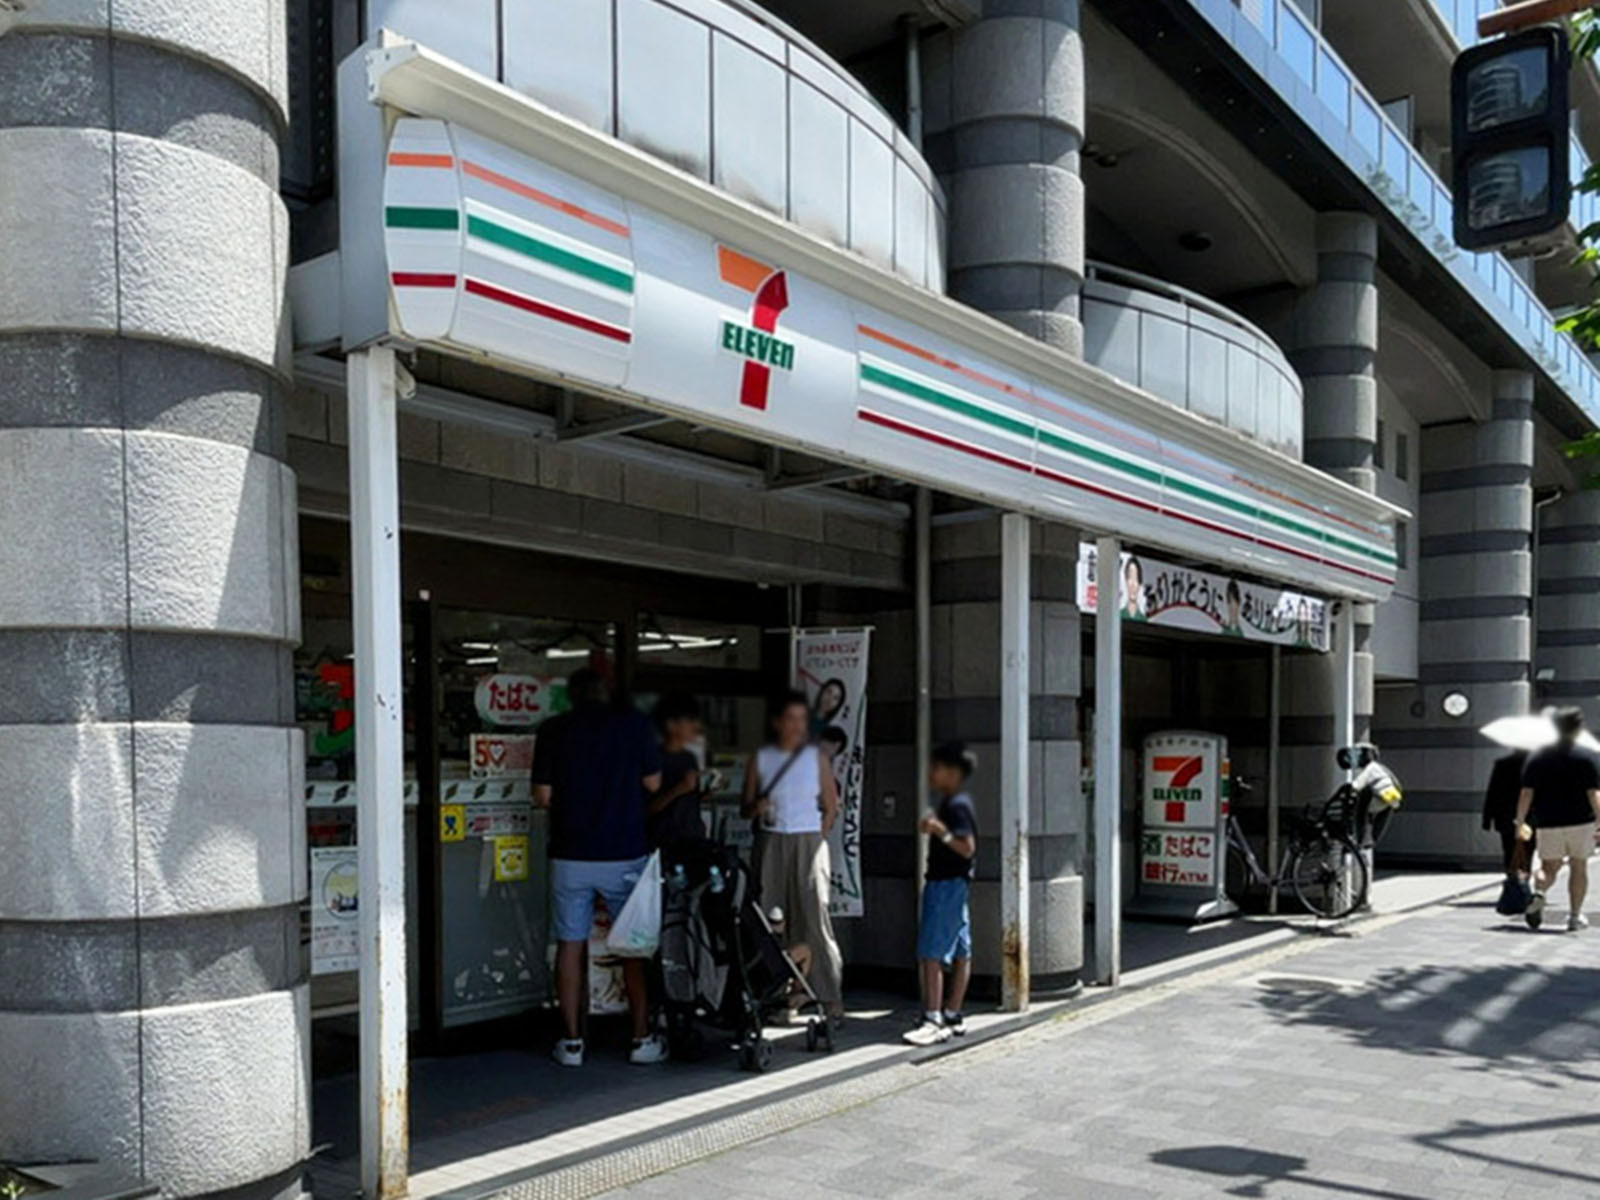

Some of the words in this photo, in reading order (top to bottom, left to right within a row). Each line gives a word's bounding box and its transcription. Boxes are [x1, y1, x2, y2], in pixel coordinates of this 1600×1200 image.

[717, 244, 789, 411] 7
[488, 682, 541, 712] たばこ
[1153, 756, 1203, 822] 7
[1164, 835, 1211, 858] たばこ
